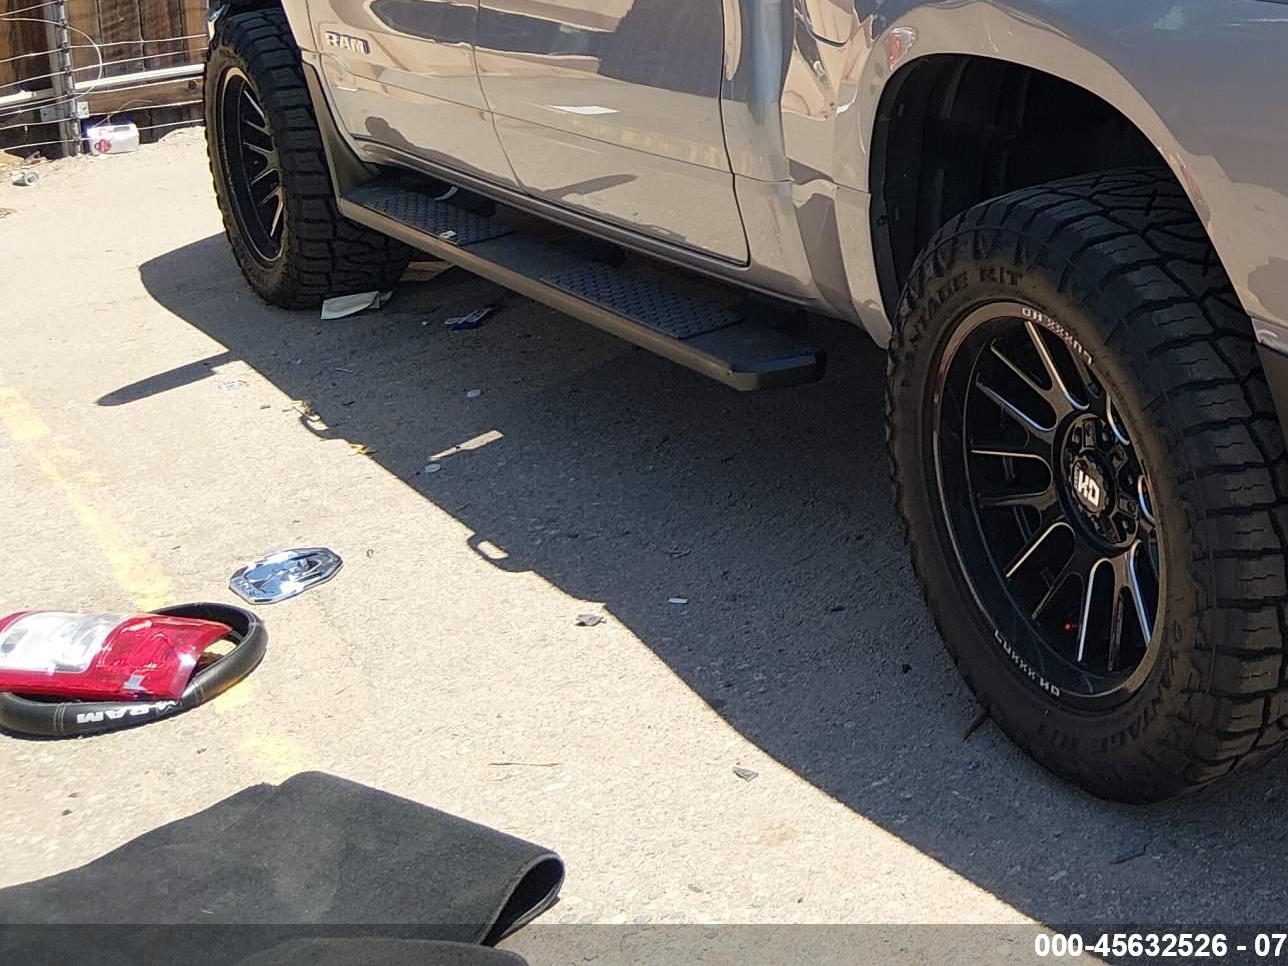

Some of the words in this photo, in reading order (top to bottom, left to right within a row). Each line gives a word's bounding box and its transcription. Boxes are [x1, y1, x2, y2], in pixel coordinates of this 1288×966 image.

[325, 33, 369, 54] RAM
[1077, 468, 1101, 508] HD
[1039, 676, 1061, 697] HD
[77, 704, 151, 724] RAM
